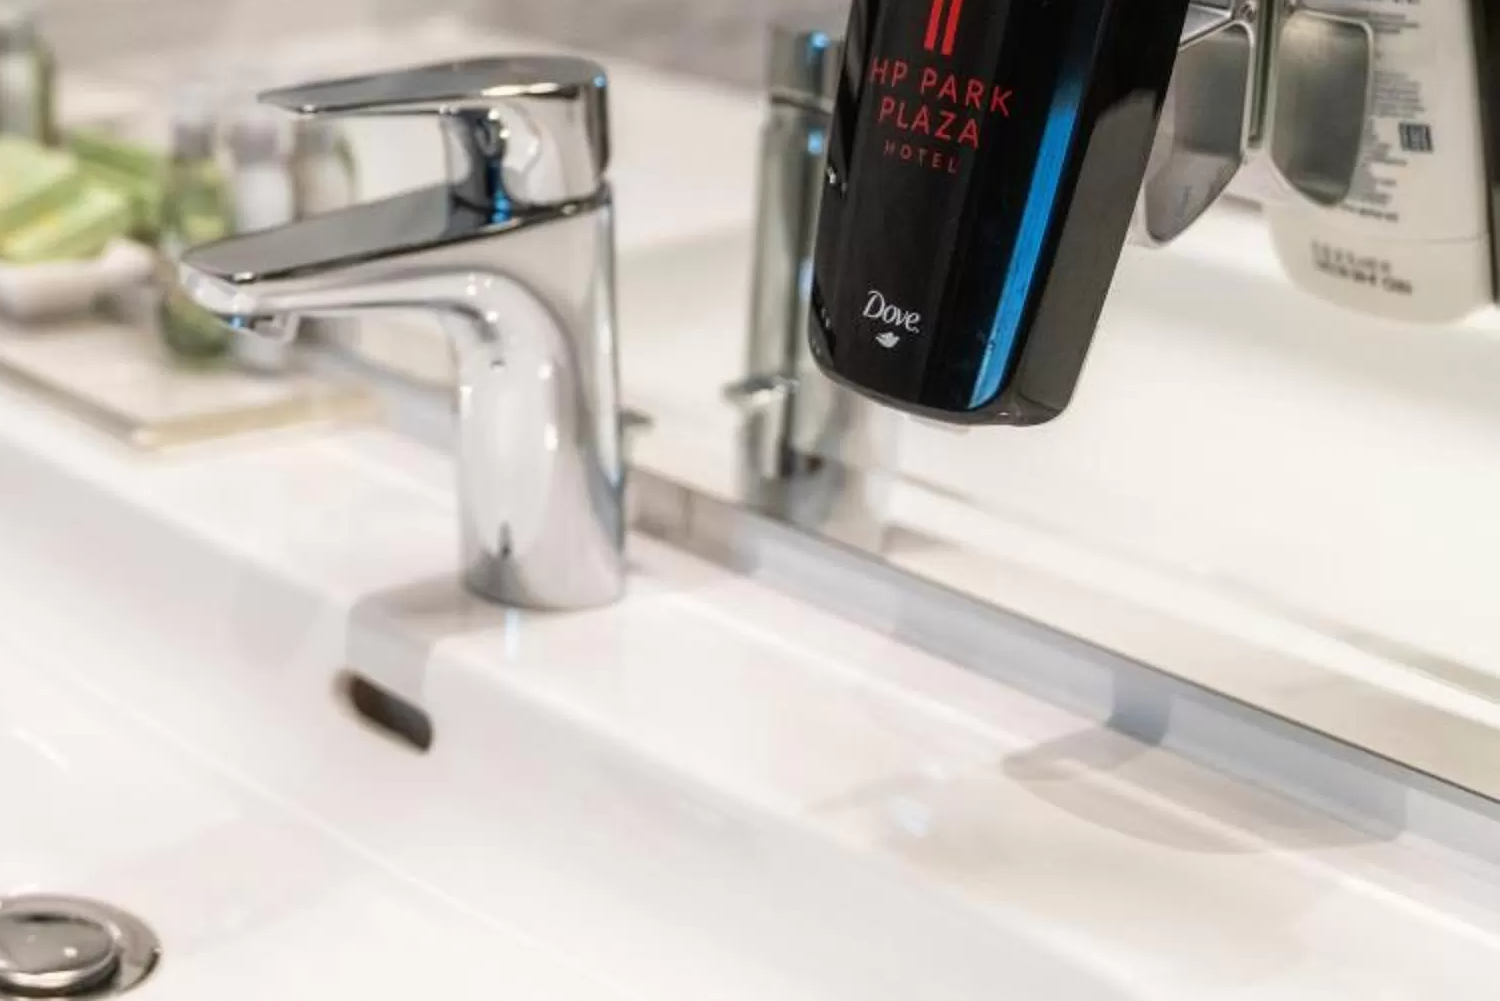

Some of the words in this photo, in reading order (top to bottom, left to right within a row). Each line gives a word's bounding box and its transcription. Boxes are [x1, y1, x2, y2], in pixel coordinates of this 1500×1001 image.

[870, 57, 908, 85] HP
[920, 70, 1014, 117] PARK
[878, 96, 981, 150] PLAZA
[883, 139, 959, 174] HOTEL
[862, 290, 919, 333] Dove
